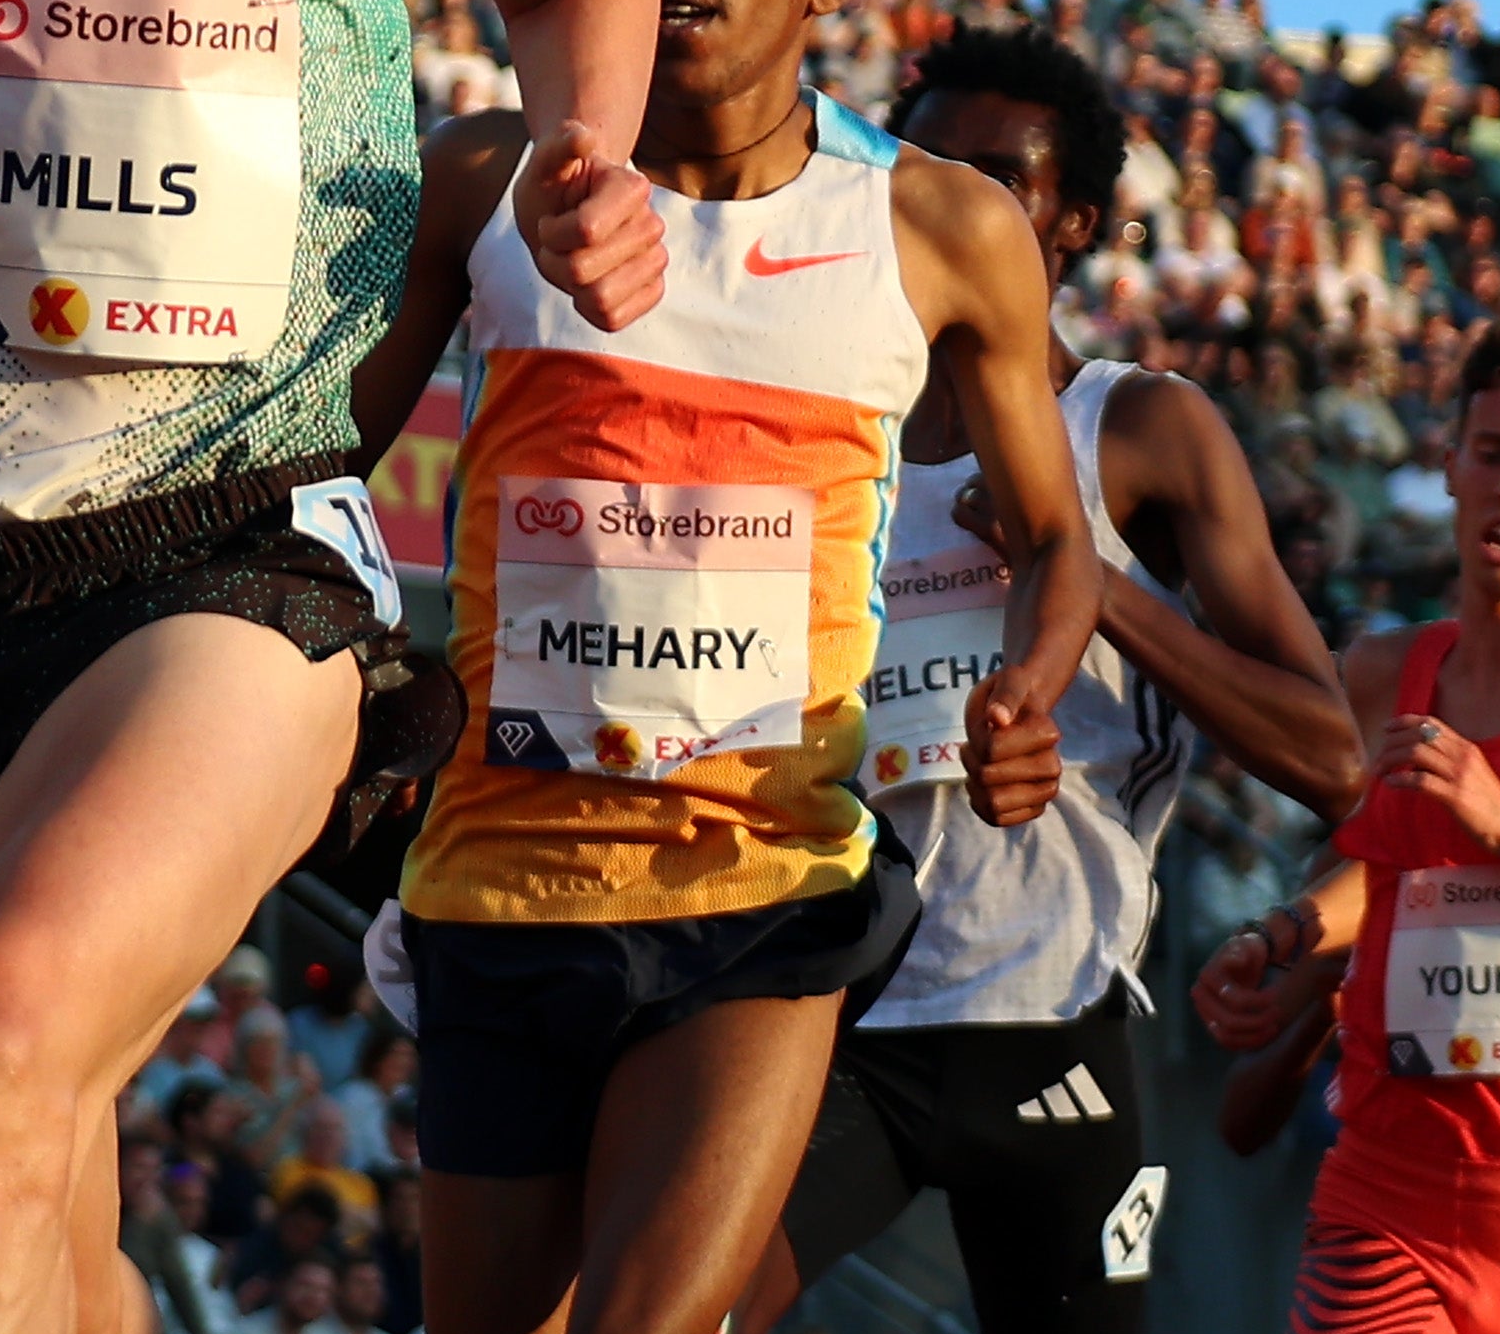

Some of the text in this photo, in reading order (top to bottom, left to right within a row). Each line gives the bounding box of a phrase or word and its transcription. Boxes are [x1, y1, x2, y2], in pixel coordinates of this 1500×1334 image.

[44, 0, 278, 53] Storebrand
[0, 150, 198, 216] MILLS
[105, 300, 238, 338] EXTRA
[597, 504, 793, 540] Storebrand
[538, 618, 760, 670] MEHARY
[1111, 1188, 1154, 1264] 13
